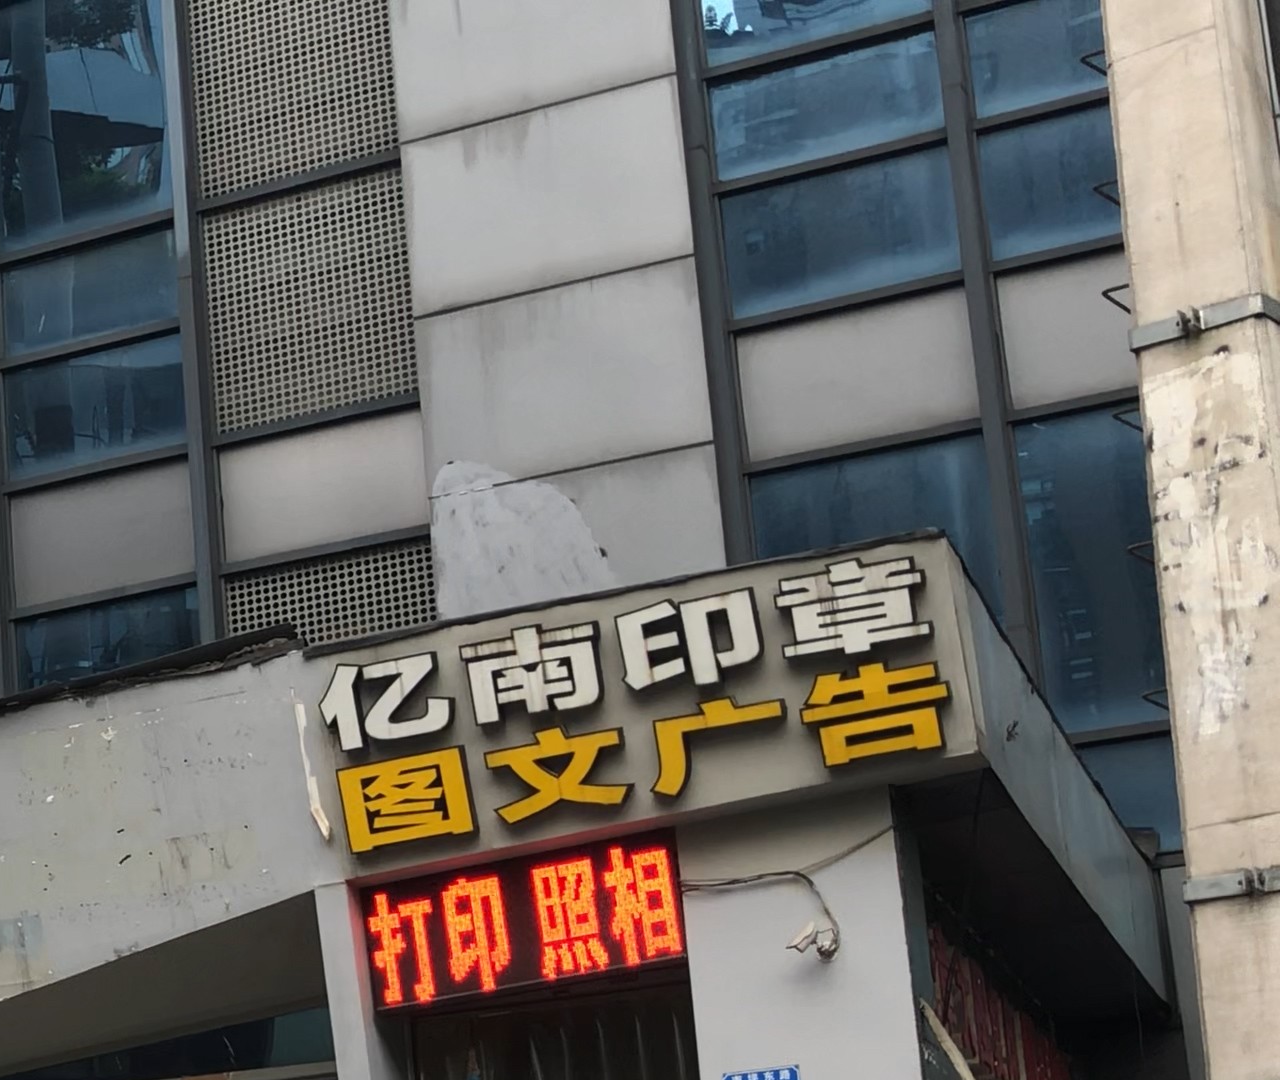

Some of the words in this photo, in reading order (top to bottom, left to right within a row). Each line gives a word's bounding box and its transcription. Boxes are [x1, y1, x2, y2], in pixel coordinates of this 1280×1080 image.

[318, 556, 934, 753] 亿南印章
[336, 661, 951, 855] 图文广告
[367, 872, 512, 1006] 打印
[529, 845, 685, 981] 照相
